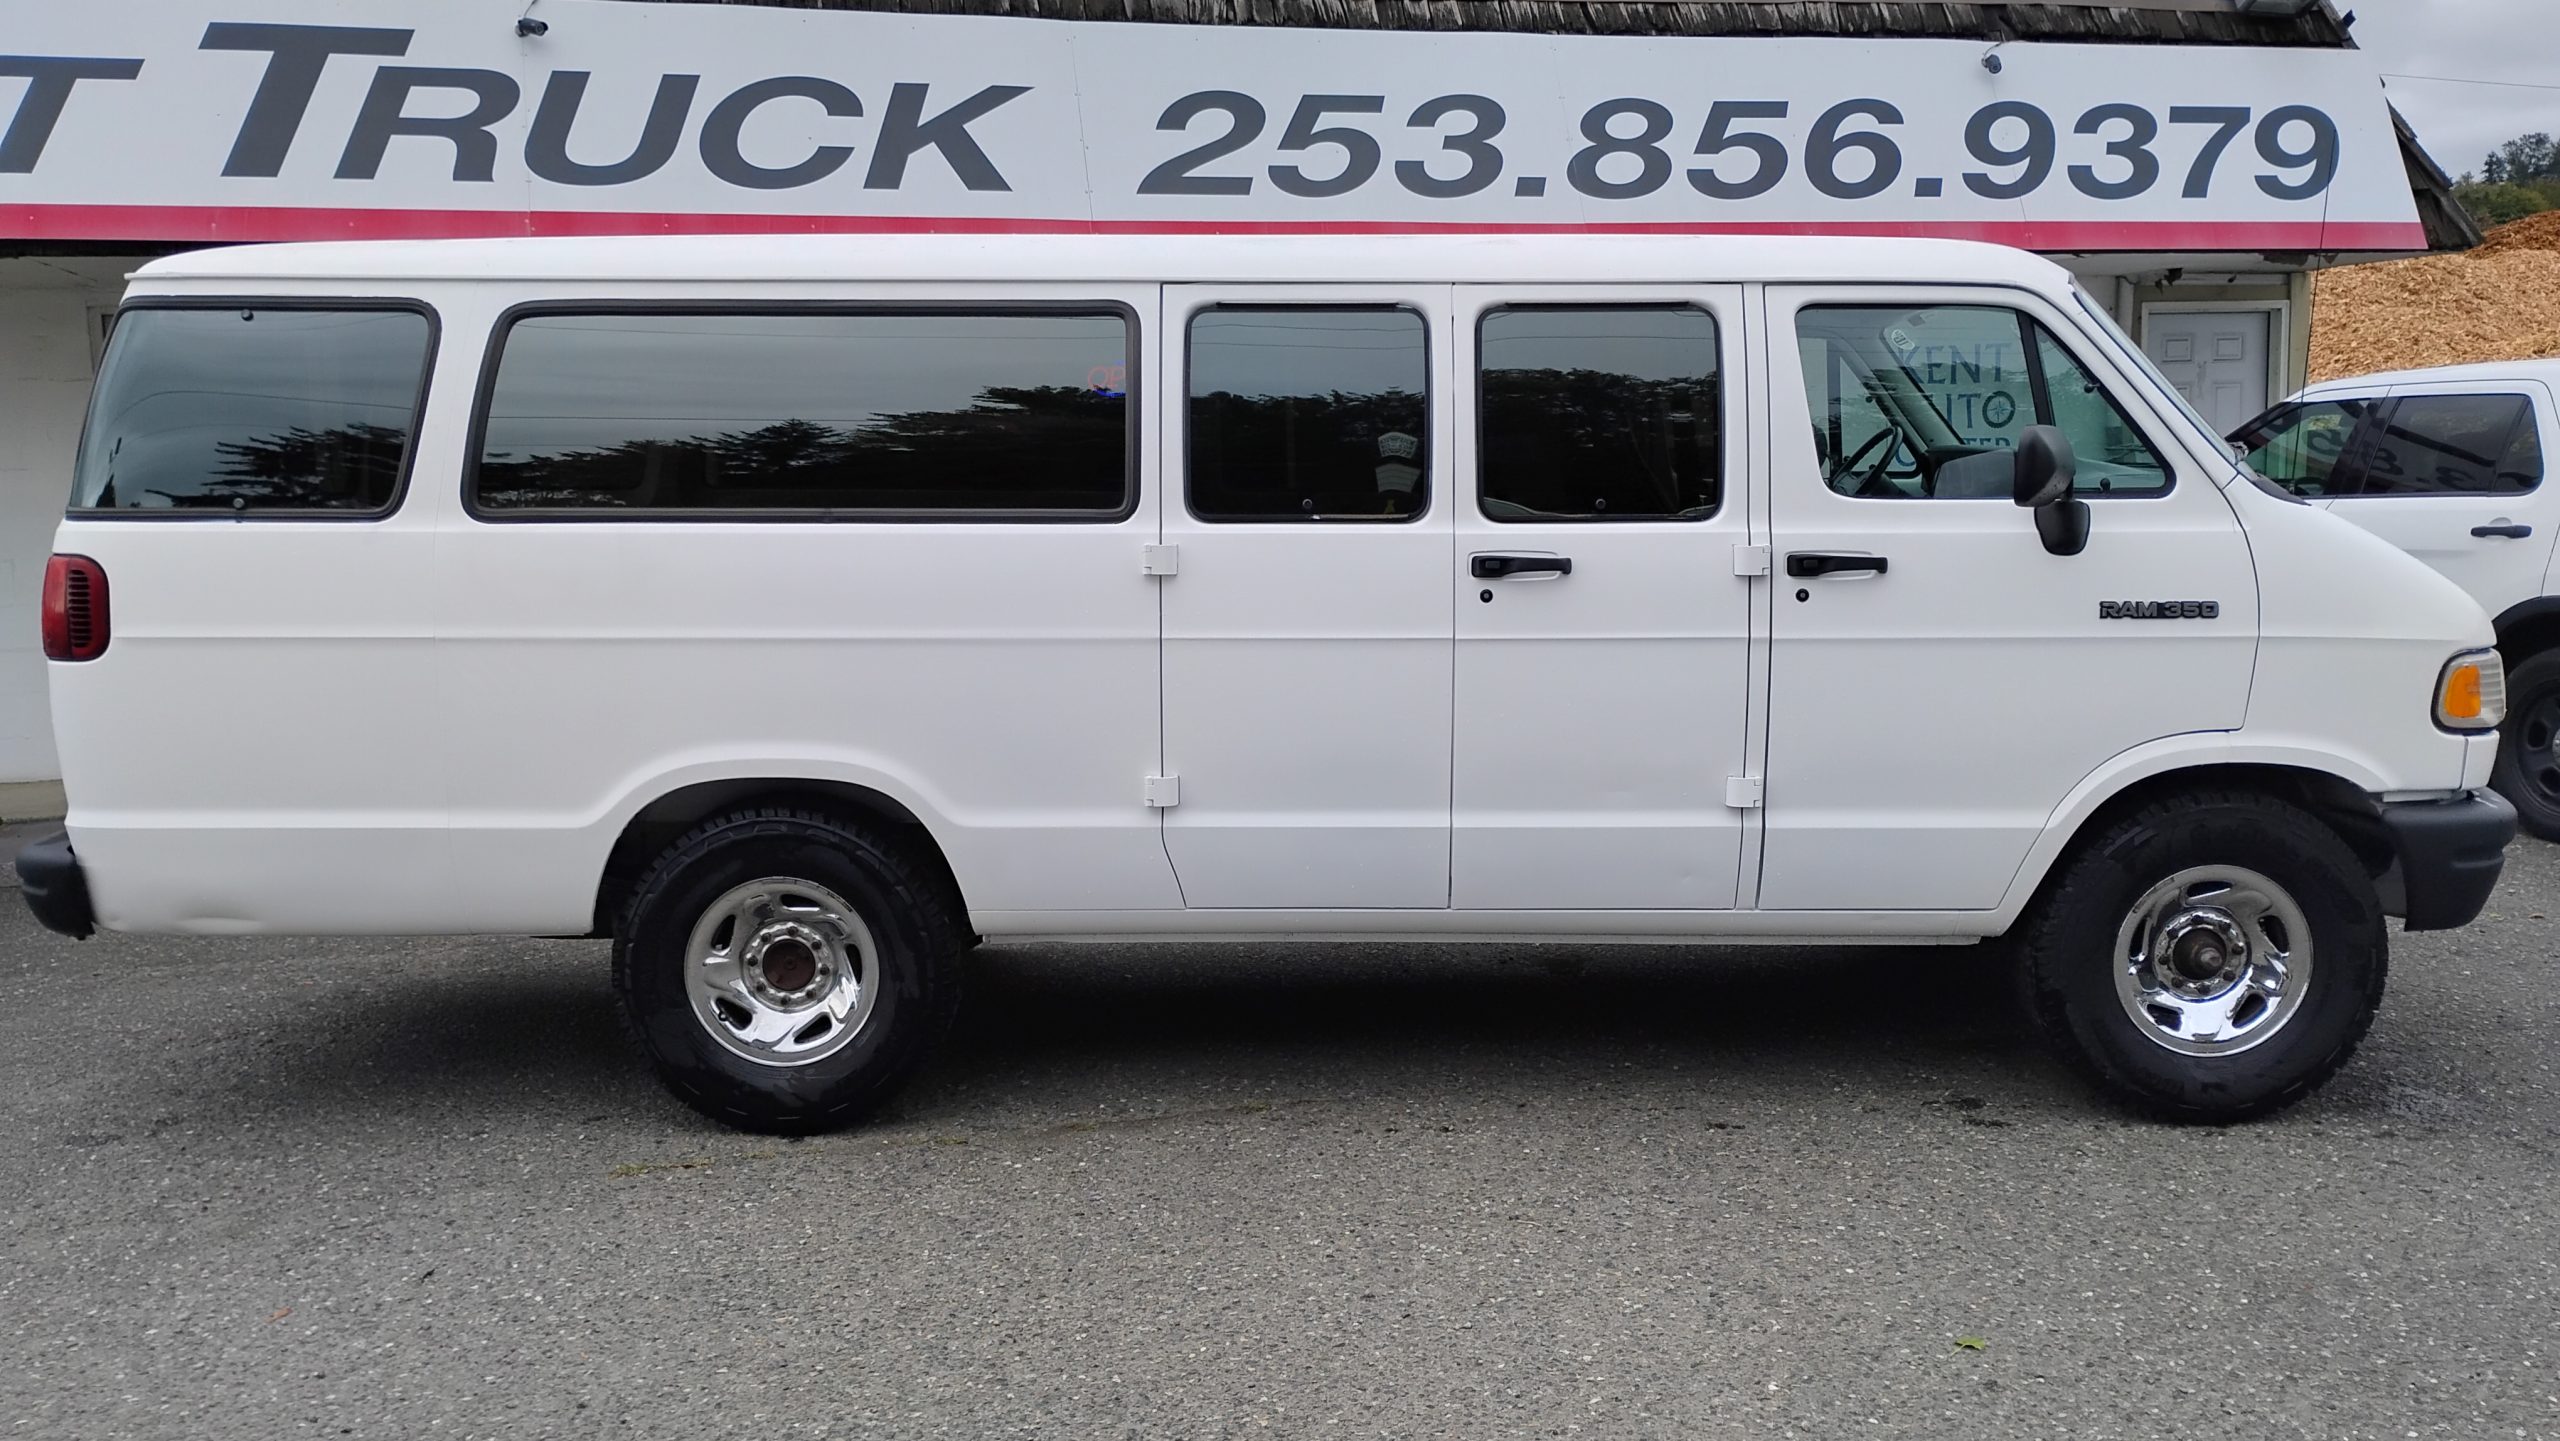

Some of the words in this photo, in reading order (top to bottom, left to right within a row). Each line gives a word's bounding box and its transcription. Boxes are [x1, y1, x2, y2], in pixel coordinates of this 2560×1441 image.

[1136, 90, 2340, 201] 253.856.9379
[1898, 342, 2012, 385] KENT
[2099, 600, 2159, 619] RAM
[2160, 600, 2219, 619] 350
